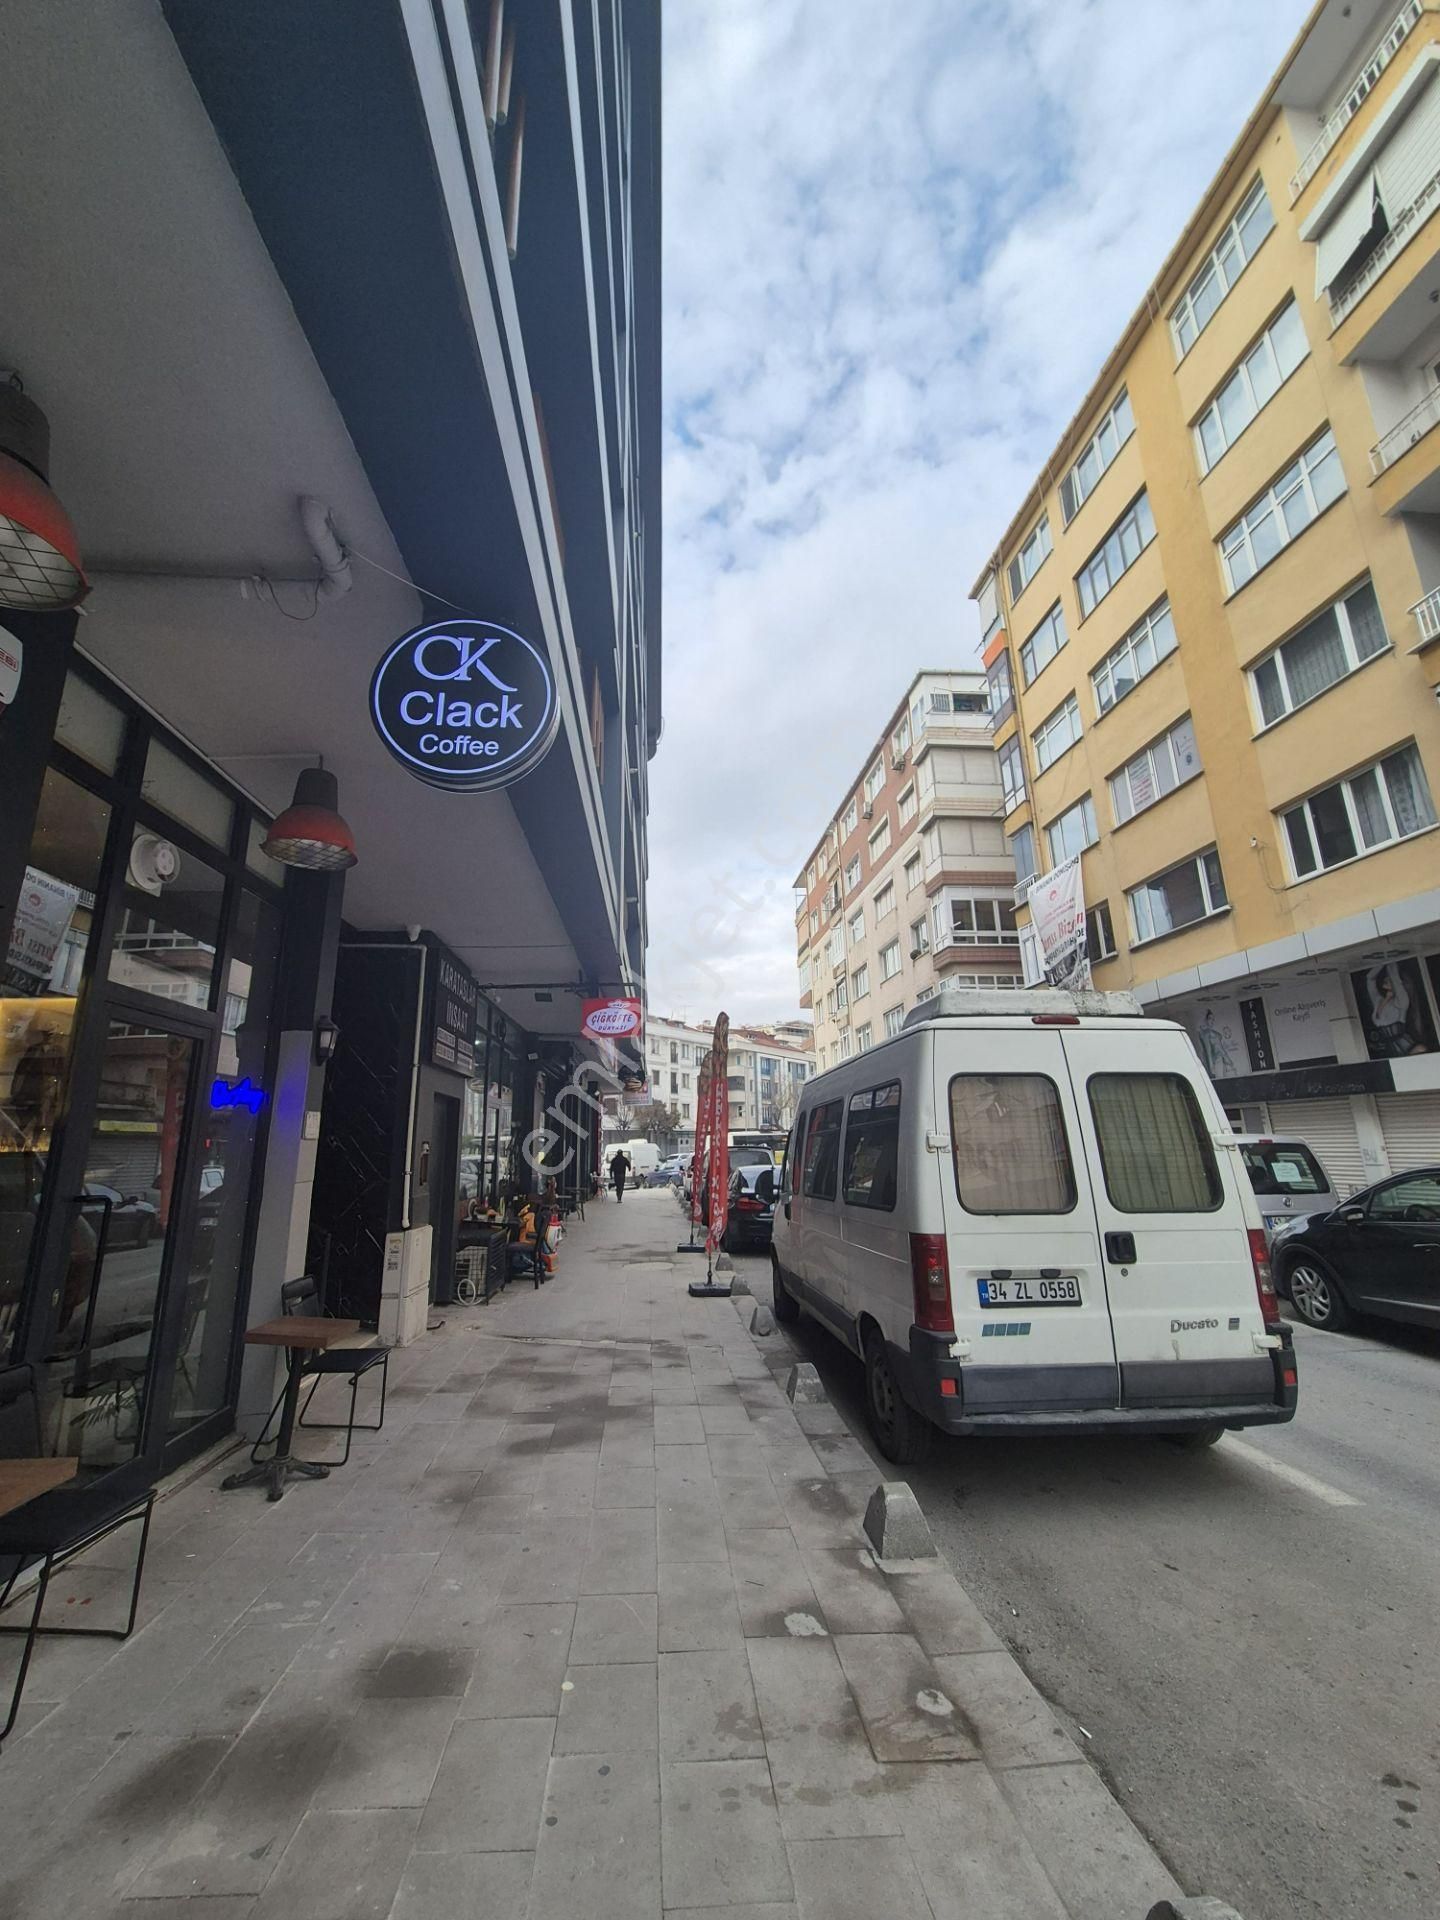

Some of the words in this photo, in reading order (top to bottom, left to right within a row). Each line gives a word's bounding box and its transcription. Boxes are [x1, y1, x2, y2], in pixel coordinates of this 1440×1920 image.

[413, 635, 518, 692] CK
[400, 690, 524, 729] Clack
[419, 734, 499, 756] Coffee
[1248, 1001, 1266, 1068] FASHION
[988, 1282, 1007, 1300] 34
[1014, 1282, 1033, 1300] ZL
[1040, 1281, 1076, 1299] 0558
[1170, 1318, 1219, 1333] Ducato
